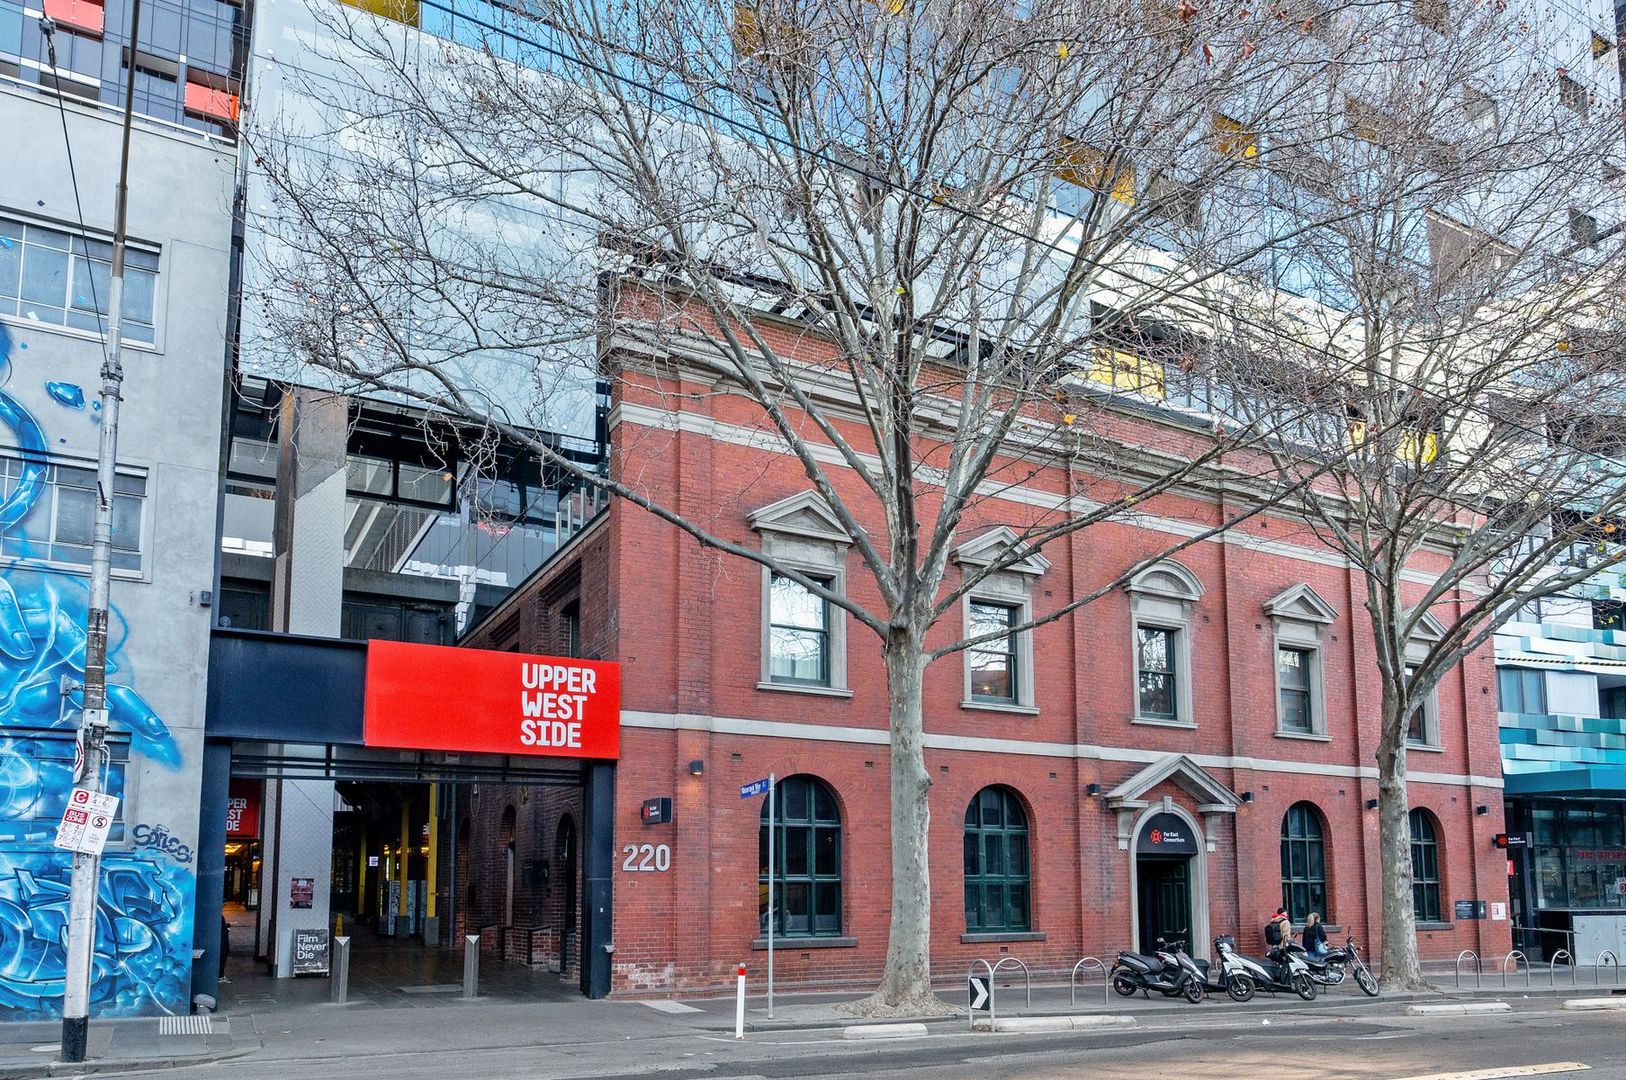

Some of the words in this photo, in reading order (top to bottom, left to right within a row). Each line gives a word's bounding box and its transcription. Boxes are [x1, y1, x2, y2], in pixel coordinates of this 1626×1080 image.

[522, 662, 597, 694] UPPER
[521, 690, 588, 721] WEST
[520, 719, 582, 748] SIDE
[226, 809, 243, 820] ST
[622, 844, 671, 872] 220
[297, 934, 319, 943] Film
[297, 943, 327, 952] Never
[297, 951, 315, 960] Die
